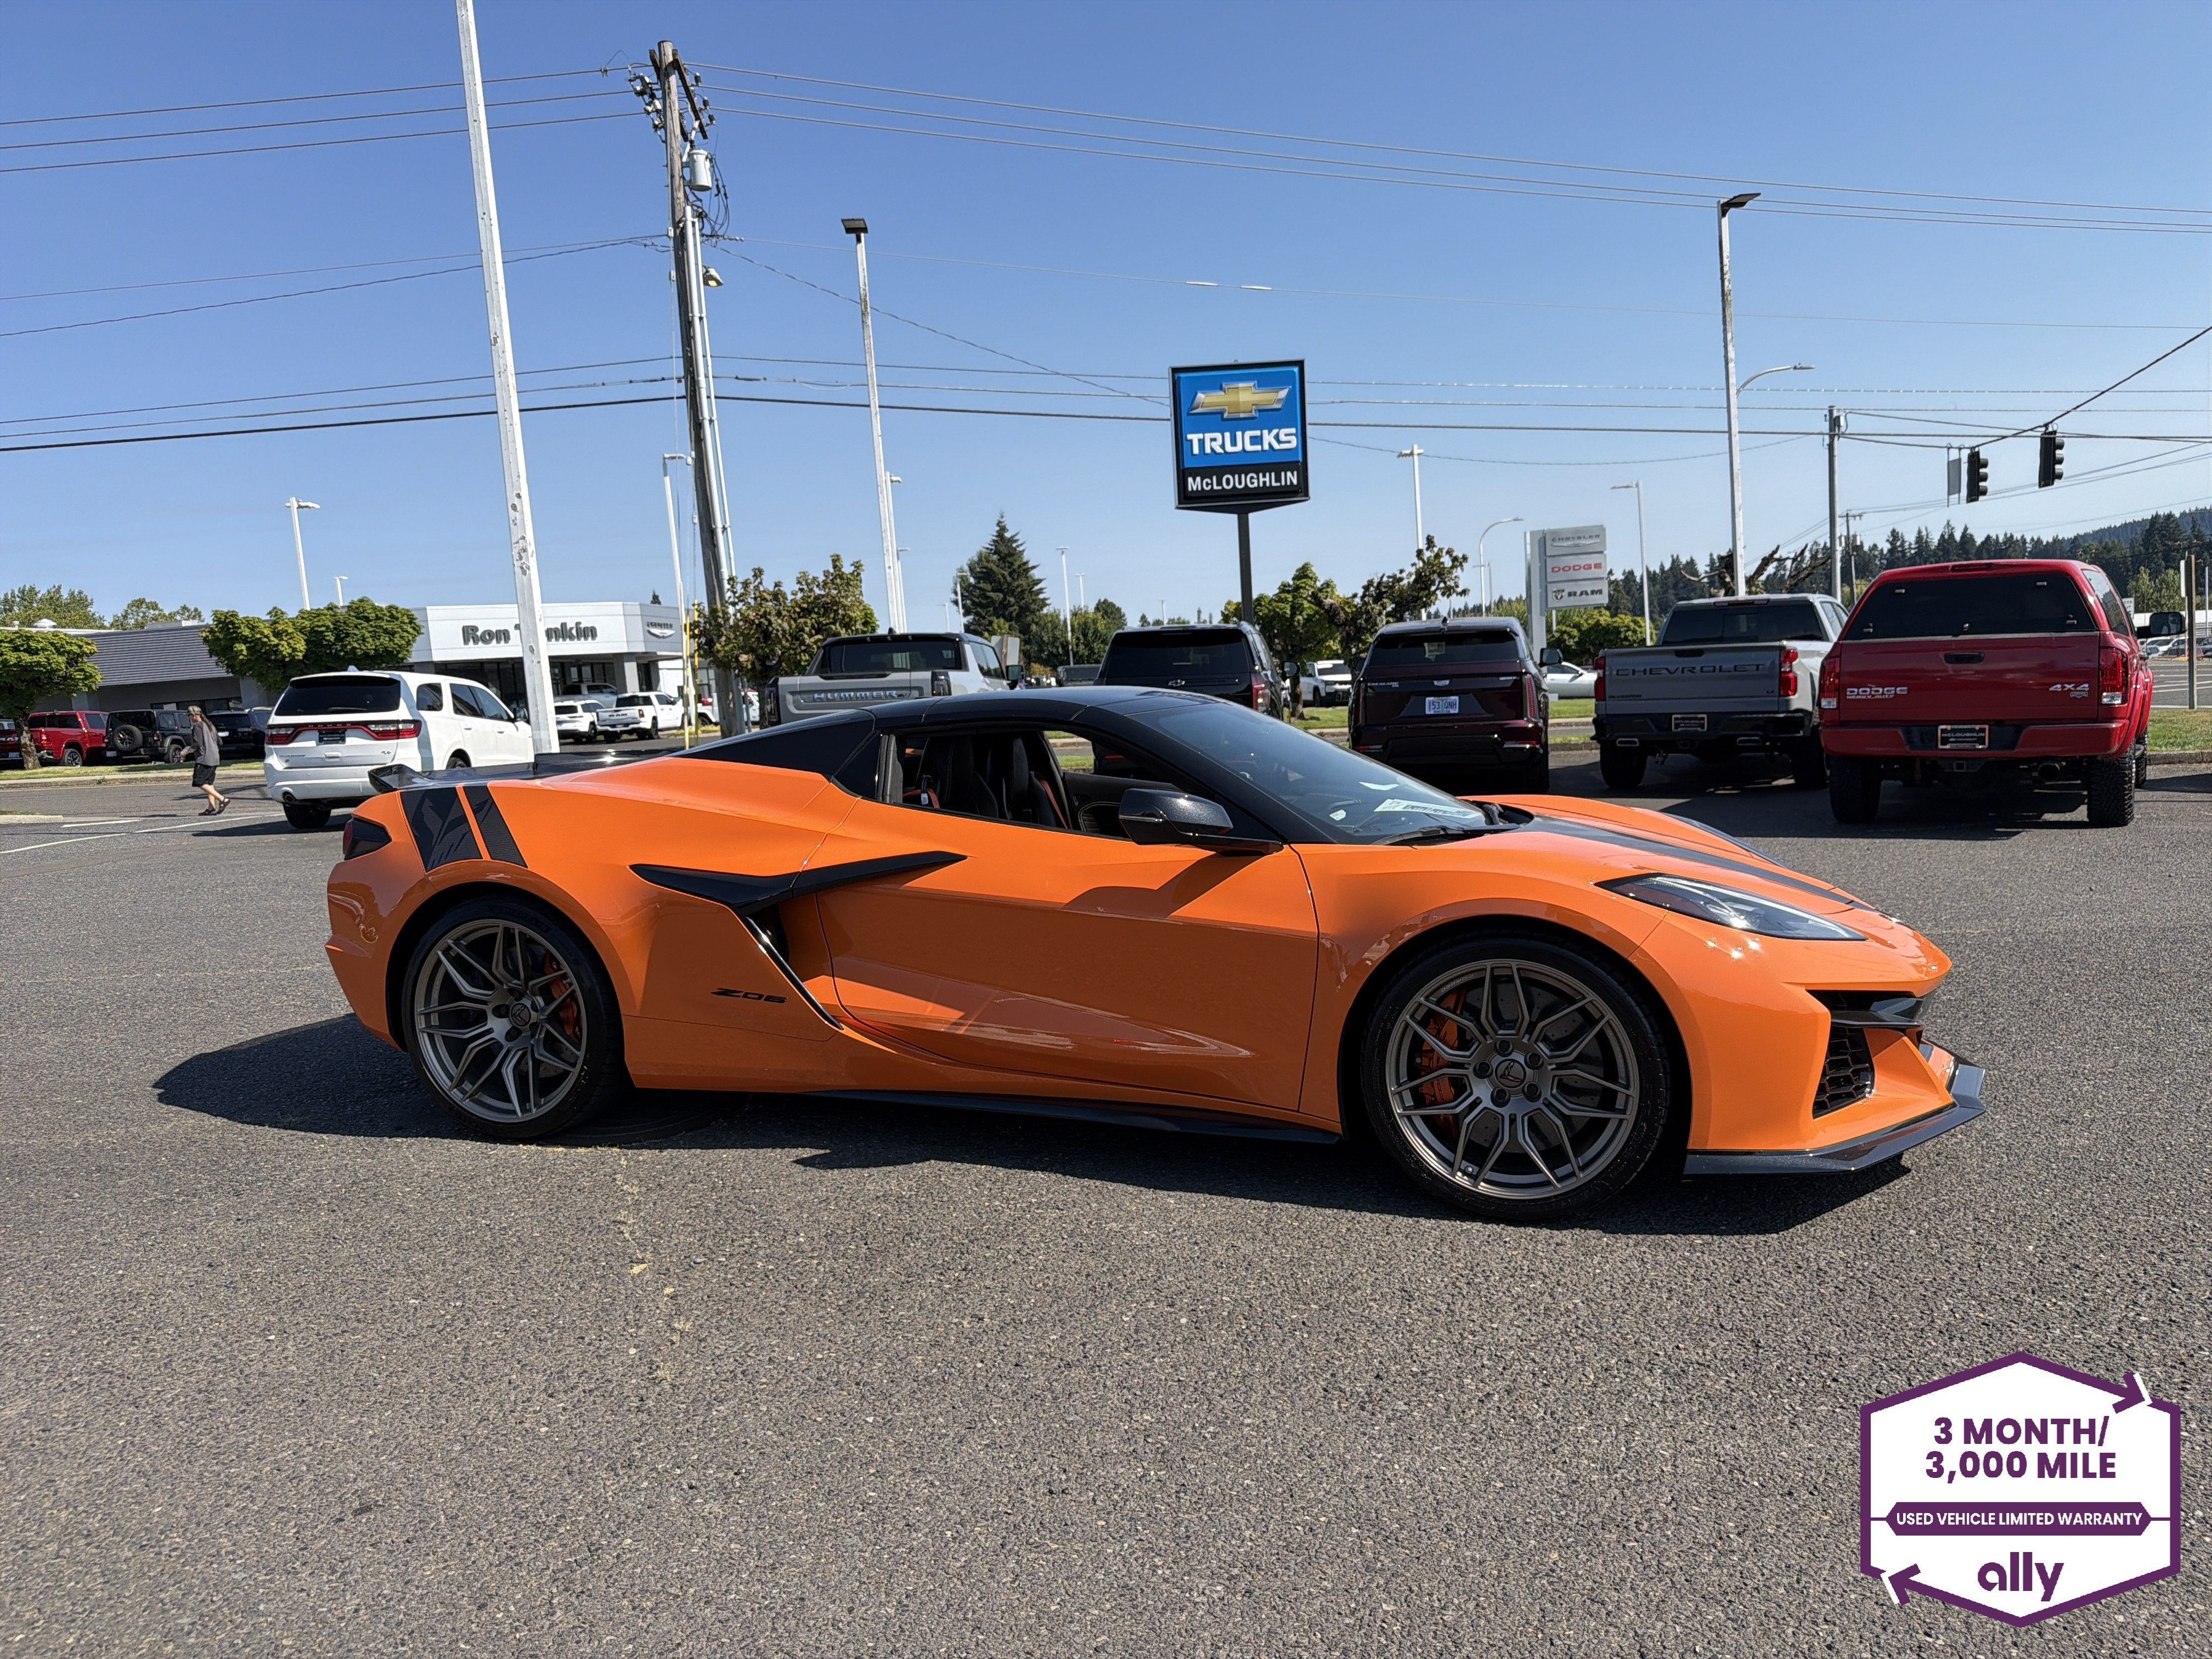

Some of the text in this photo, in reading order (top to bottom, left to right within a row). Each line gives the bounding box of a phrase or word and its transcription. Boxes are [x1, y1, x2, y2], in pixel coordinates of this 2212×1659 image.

[1187, 428, 1297, 454] TRUCKS
[1188, 471, 1298, 492] McLOUGHLIN
[1551, 562, 1602, 573] DODGE
[1567, 589, 1603, 597] RAM
[462, 622, 597, 645] Ron nkin
[1616, 664, 1765, 676] CHEVROLET
[813, 691, 898, 701] HUMMER
[1847, 686, 1908, 695] DODGE
[1429, 701, 1457, 711] 153 QNH
[710, 988, 788, 1003] Z06
